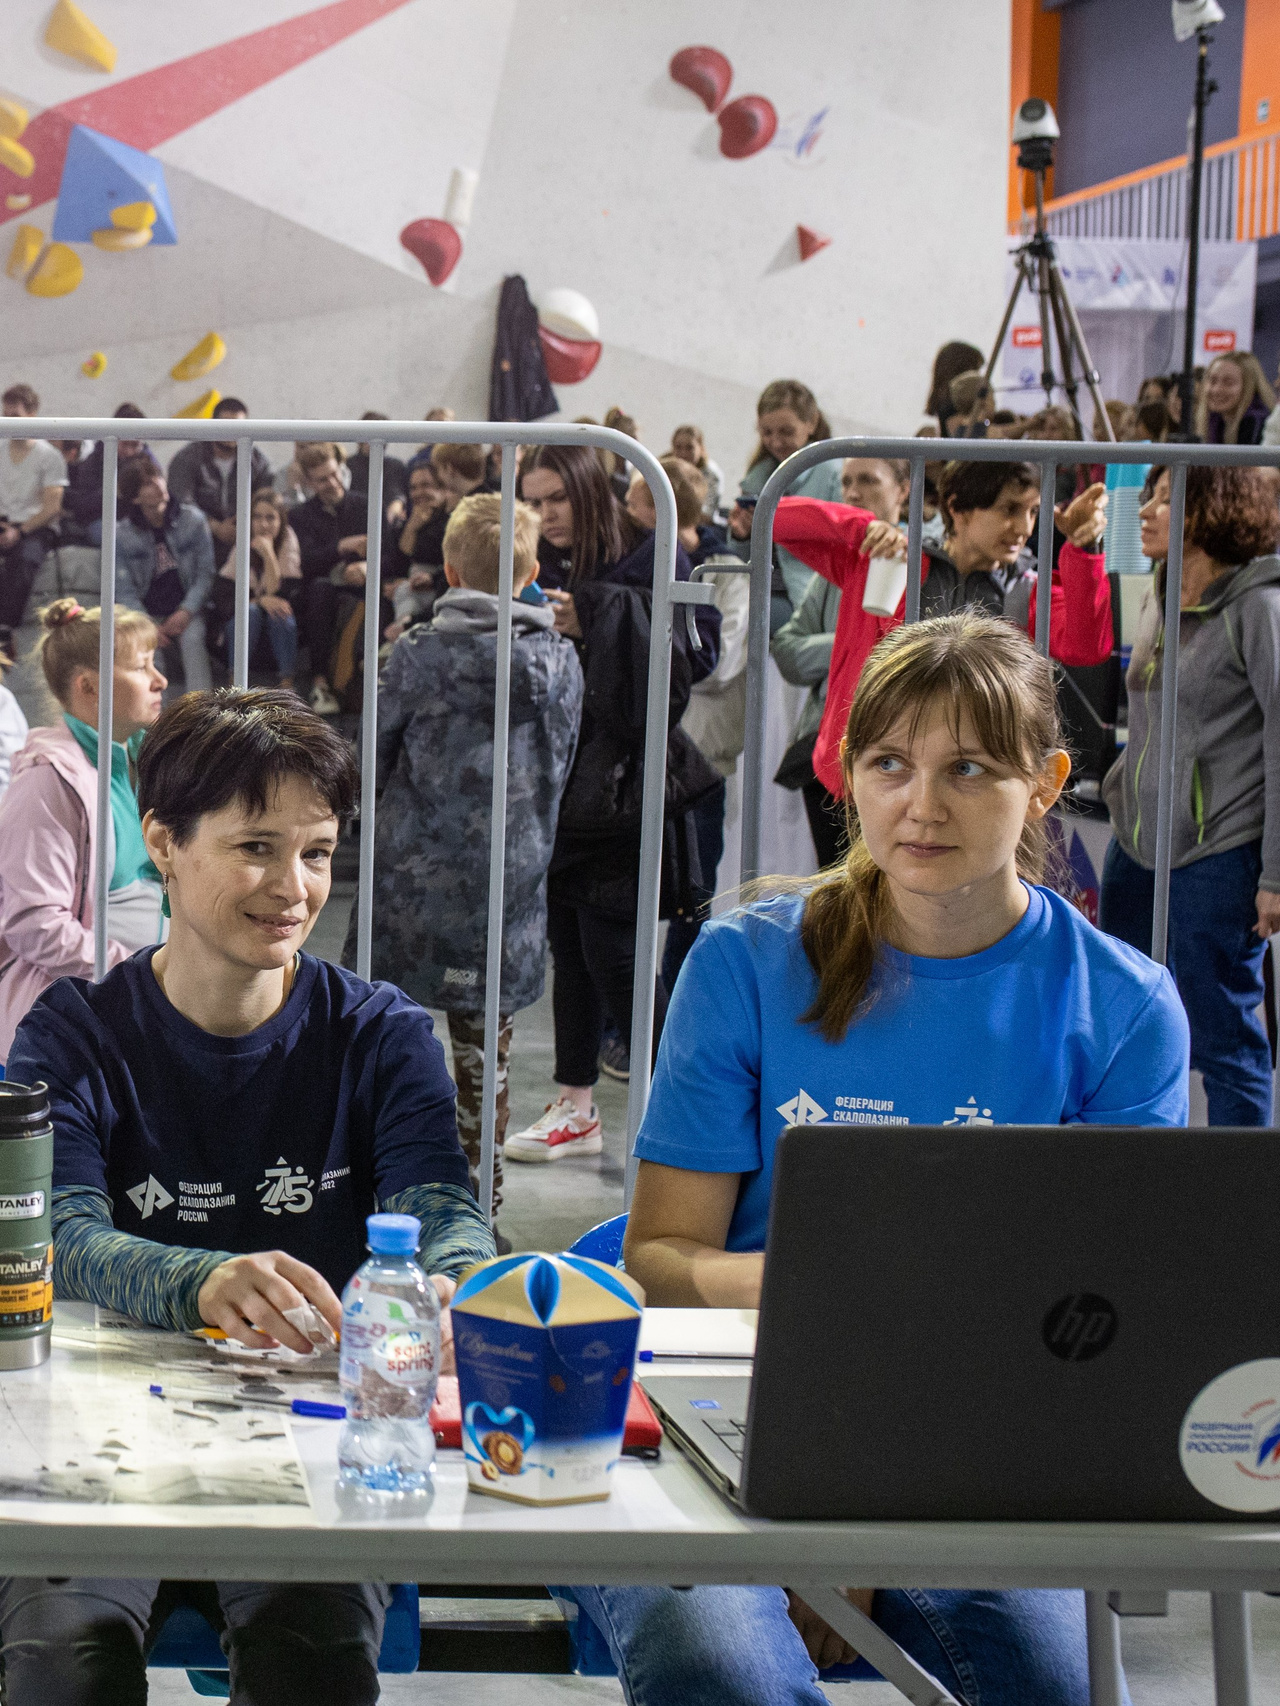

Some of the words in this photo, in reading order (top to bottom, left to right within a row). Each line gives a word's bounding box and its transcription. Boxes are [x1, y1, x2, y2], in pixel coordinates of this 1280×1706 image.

[835, 1096, 894, 1112] ФЕДЕРАЦИЯ
[833, 1110, 910, 1126] СКАЛОЛАЗАНИЯ
[178, 1181, 223, 1195] ФЕДЕРАЦИЯ
[178, 1194, 236, 1209] СКАЛОЛАЗАНИЯ
[177, 1209, 209, 1223] РОССИИ
[1051, 1292, 1112, 1359] hp
[394, 1341, 431, 1358] saint
[387, 1356, 434, 1375] spring
